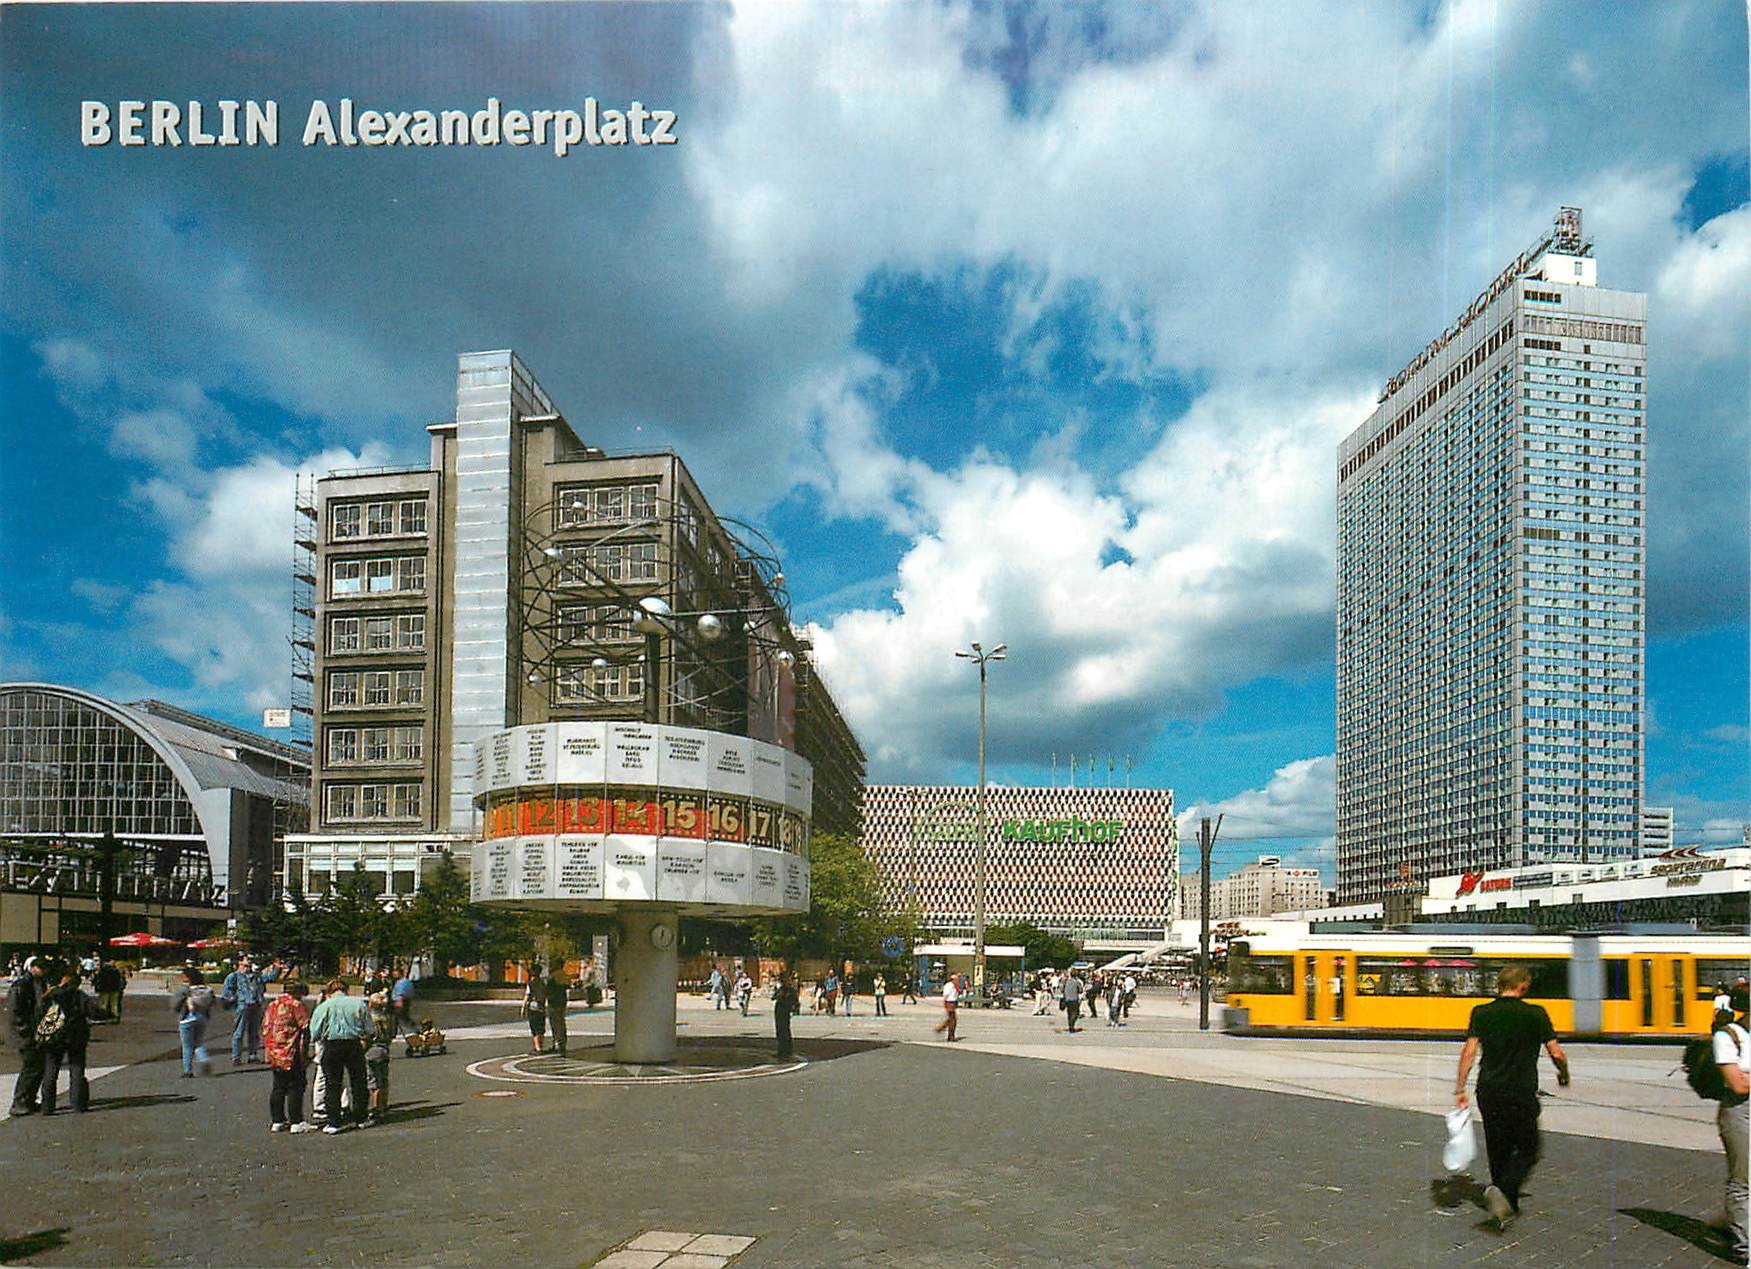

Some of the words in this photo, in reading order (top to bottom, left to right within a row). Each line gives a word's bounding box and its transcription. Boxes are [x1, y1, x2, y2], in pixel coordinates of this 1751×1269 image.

[529, 799, 556, 828] 12
[569, 798, 600, 826] 13
[612, 799, 649, 827] 14
[663, 800, 697, 831] 15
[709, 804, 739, 833] 16
[751, 809, 770, 837] 17
